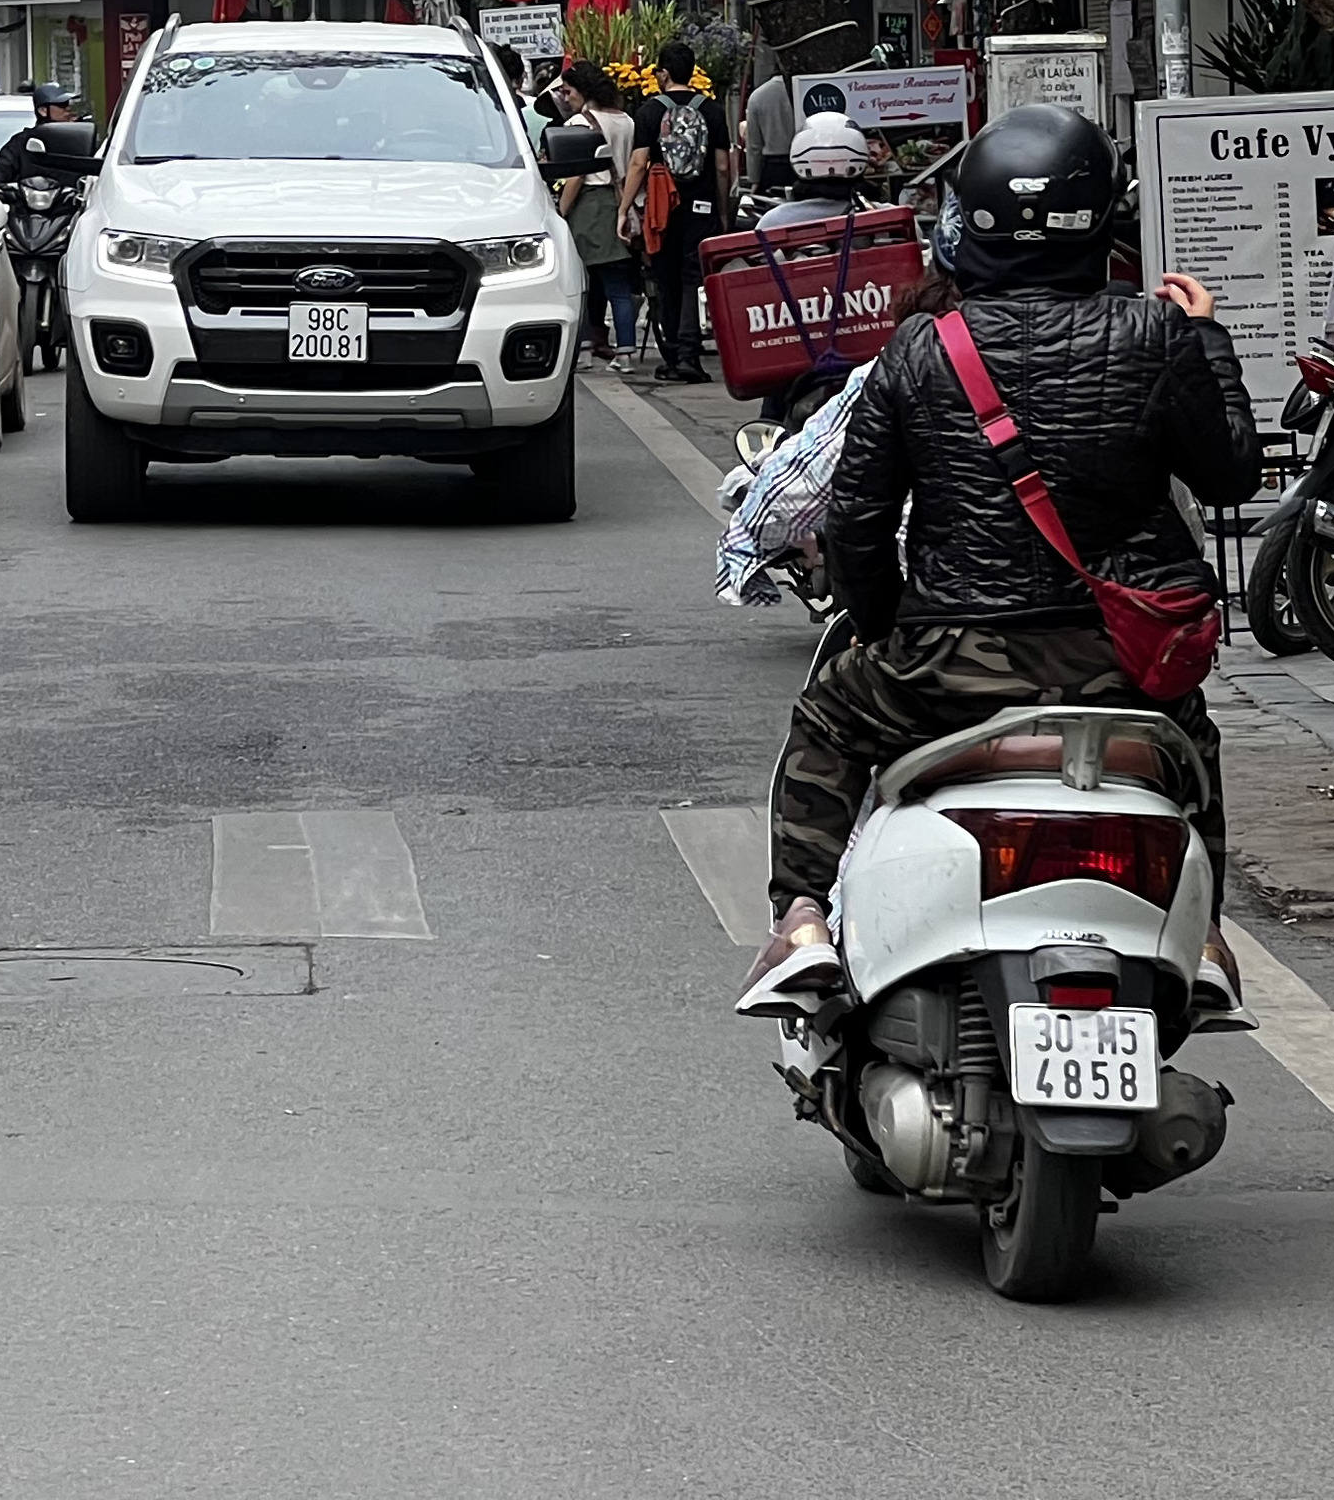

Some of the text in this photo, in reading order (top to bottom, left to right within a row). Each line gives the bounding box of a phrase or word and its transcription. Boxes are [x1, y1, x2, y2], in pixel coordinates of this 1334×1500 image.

[903, 76, 960, 90] Restaurant
[870, 97, 924, 113] Vegetarian
[926, 92, 956, 106] Food
[1210, 127, 1290, 161] Cafe
[308, 308, 349, 331] 98C
[745, 301, 796, 334] BIA
[842, 280, 892, 320] NỘI
[291, 334, 362, 359] 200.81
[1035, 1058, 1138, 1102] 4858
